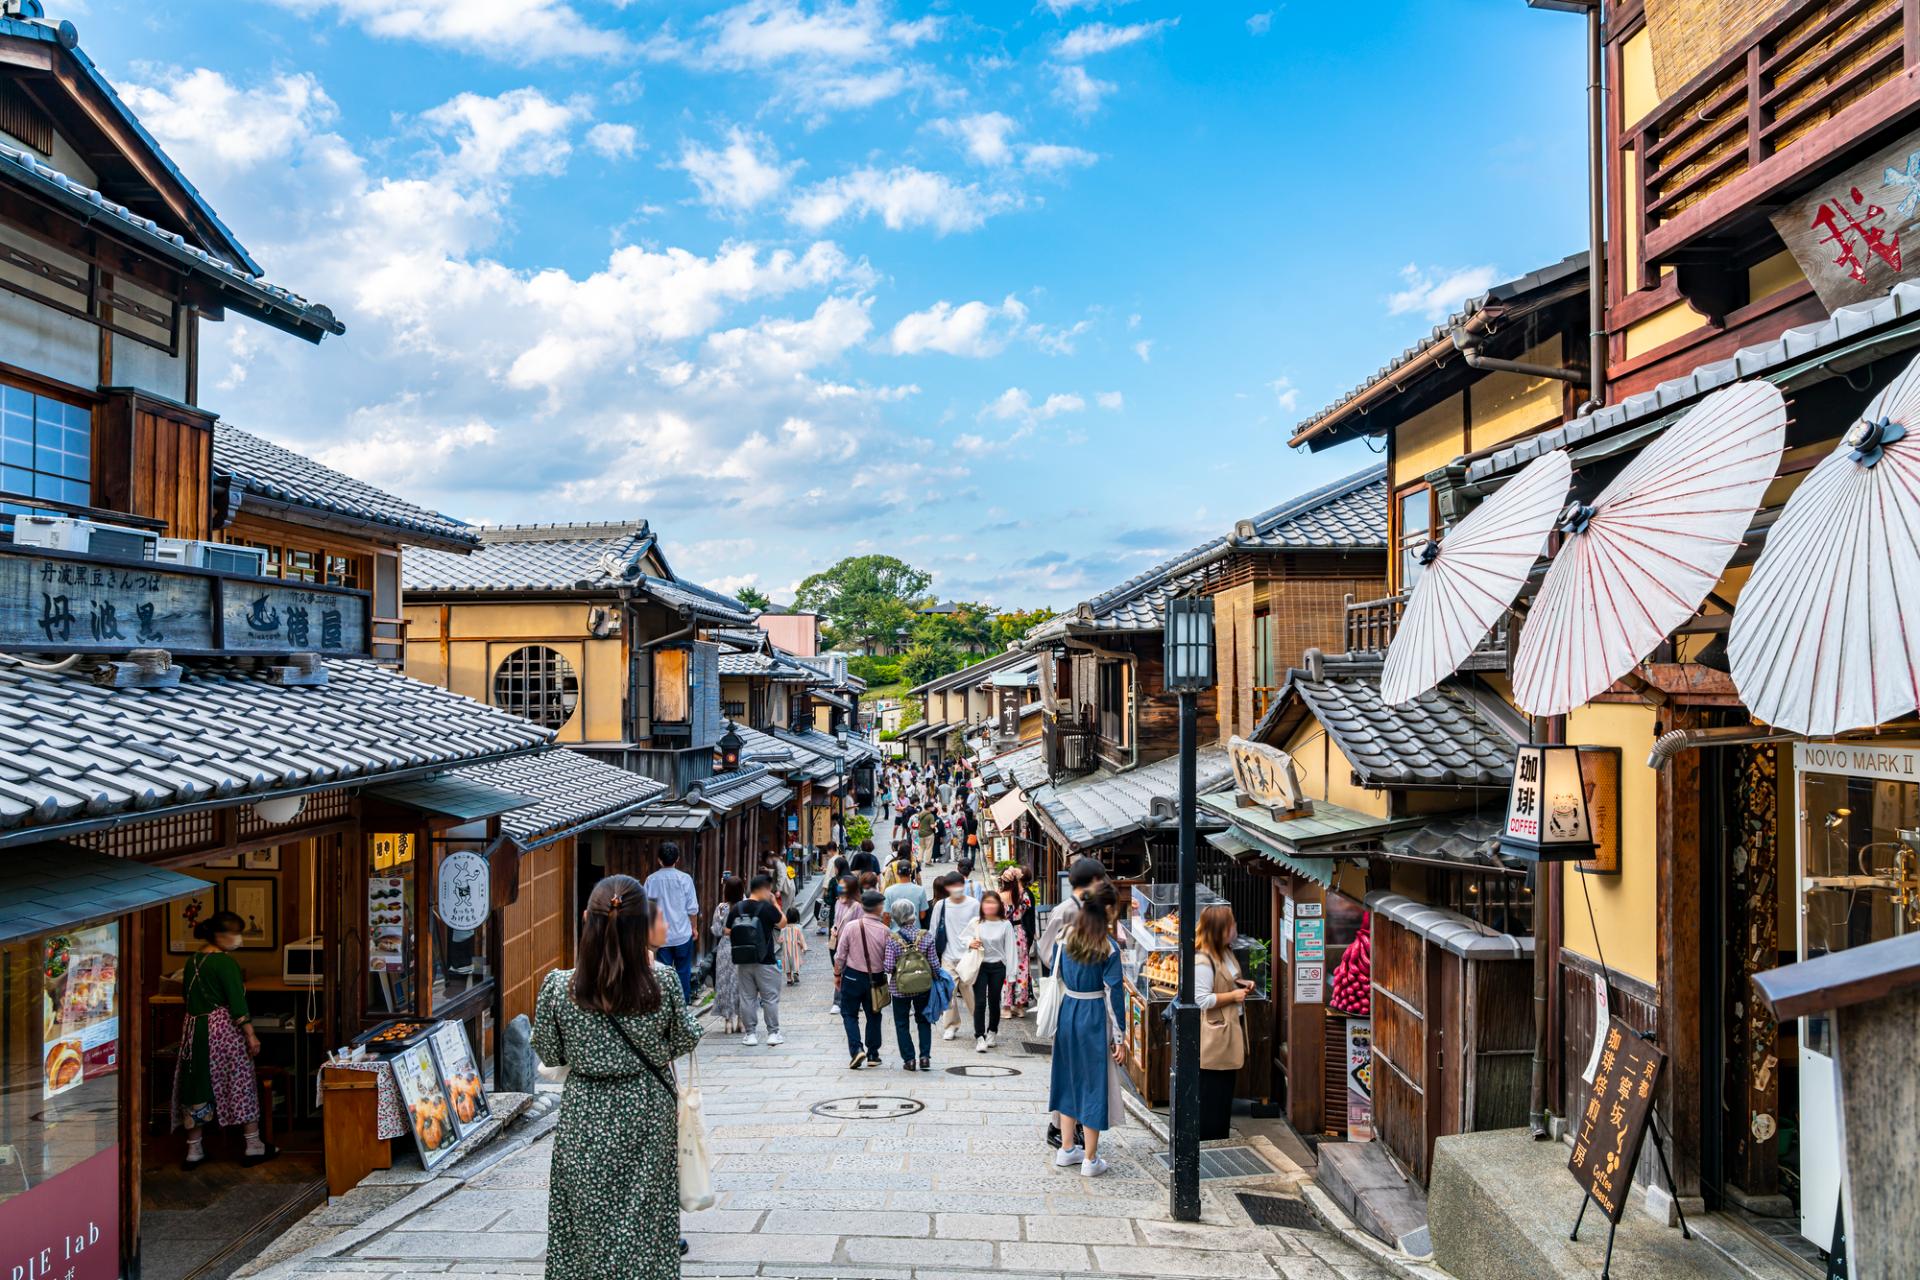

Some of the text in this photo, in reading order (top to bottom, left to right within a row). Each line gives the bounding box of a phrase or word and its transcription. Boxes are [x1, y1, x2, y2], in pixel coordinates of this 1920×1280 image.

[38, 592, 164, 645] 丹波黒
[287, 606, 342, 648] 港屋
[1805, 749, 1847, 768] NOVO
[1853, 751, 1899, 773] MARK
[1516, 755, 1538, 816] 珈琲
[1510, 818, 1537, 835] COFFEE
[1573, 1027, 1622, 1168] 珈琲焙煎工房
[1611, 1054, 1639, 1128] 二寧坂
[1637, 1060, 1655, 1098] 京都
[1592, 1163, 1612, 1192] Coffee
[1591, 1182, 1615, 1213] Roaster
[65, 1221, 99, 1260] lab
